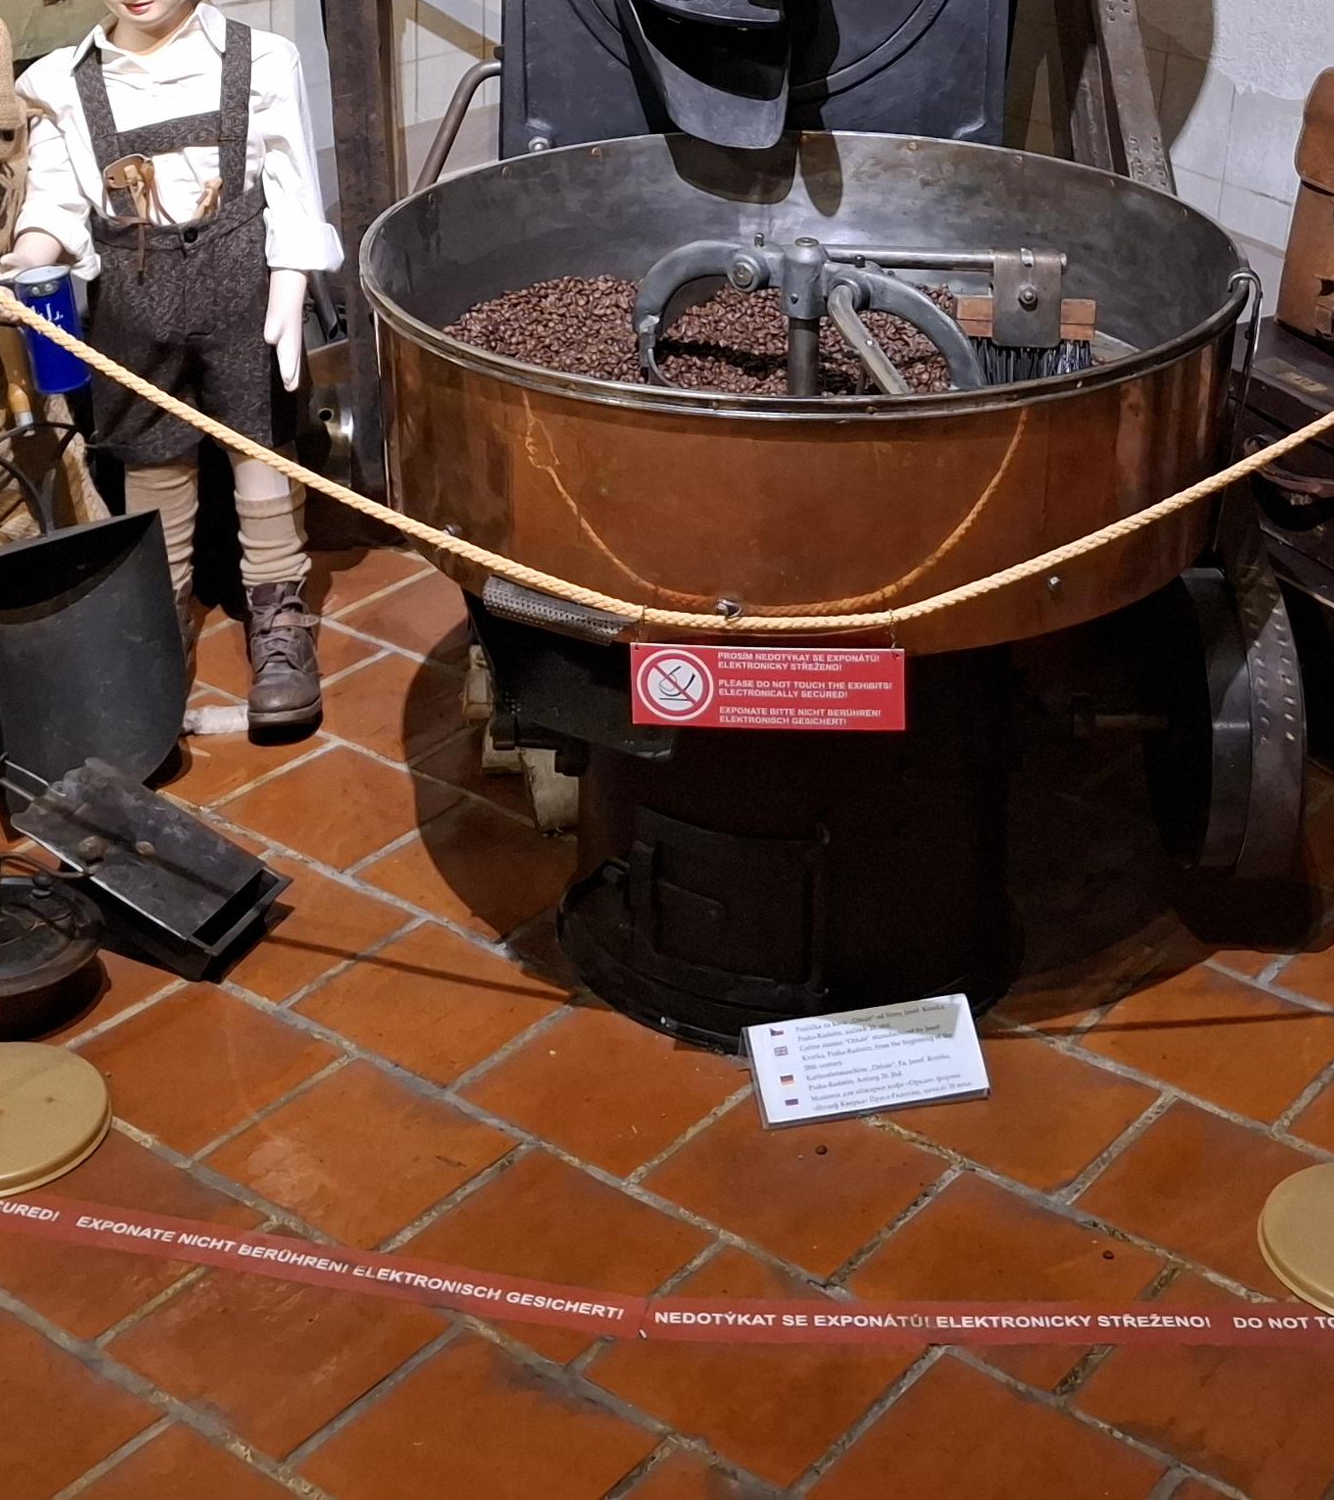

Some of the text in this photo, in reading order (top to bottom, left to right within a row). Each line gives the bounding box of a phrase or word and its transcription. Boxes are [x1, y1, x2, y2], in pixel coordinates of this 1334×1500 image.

[717, 651, 754, 660] PROSÍM
[812, 654, 825, 662] SE
[718, 661, 788, 670] ELEKTRONICKY
[718, 679, 754, 687] PLEASE
[756, 680, 770, 688] DO
[794, 681, 825, 689] TOUCH
[718, 688, 848, 698] ELECTRONICALLY SECURED!
[719, 706, 767, 715] EXPONATE
[770, 707, 795, 715] BITTE
[798, 708, 825, 716] NICHT
[719, 715, 789, 724] ELEKTRONISCH
[75, 1216, 624, 1320] EXPONATE NICHT BERÜHREN! ELEKTRONISCH GESICHERT!
[655, 1311, 776, 1326] NEDOTÝKAT
[782, 1315, 808, 1326] SE
[936, 1315, 1092, 1328] ELEKTRONICKY
[1098, 1313, 1211, 1328] STŘEŽENO!
[1233, 1316, 1263, 1329] DO
[1268, 1316, 1309, 1329] NOT
